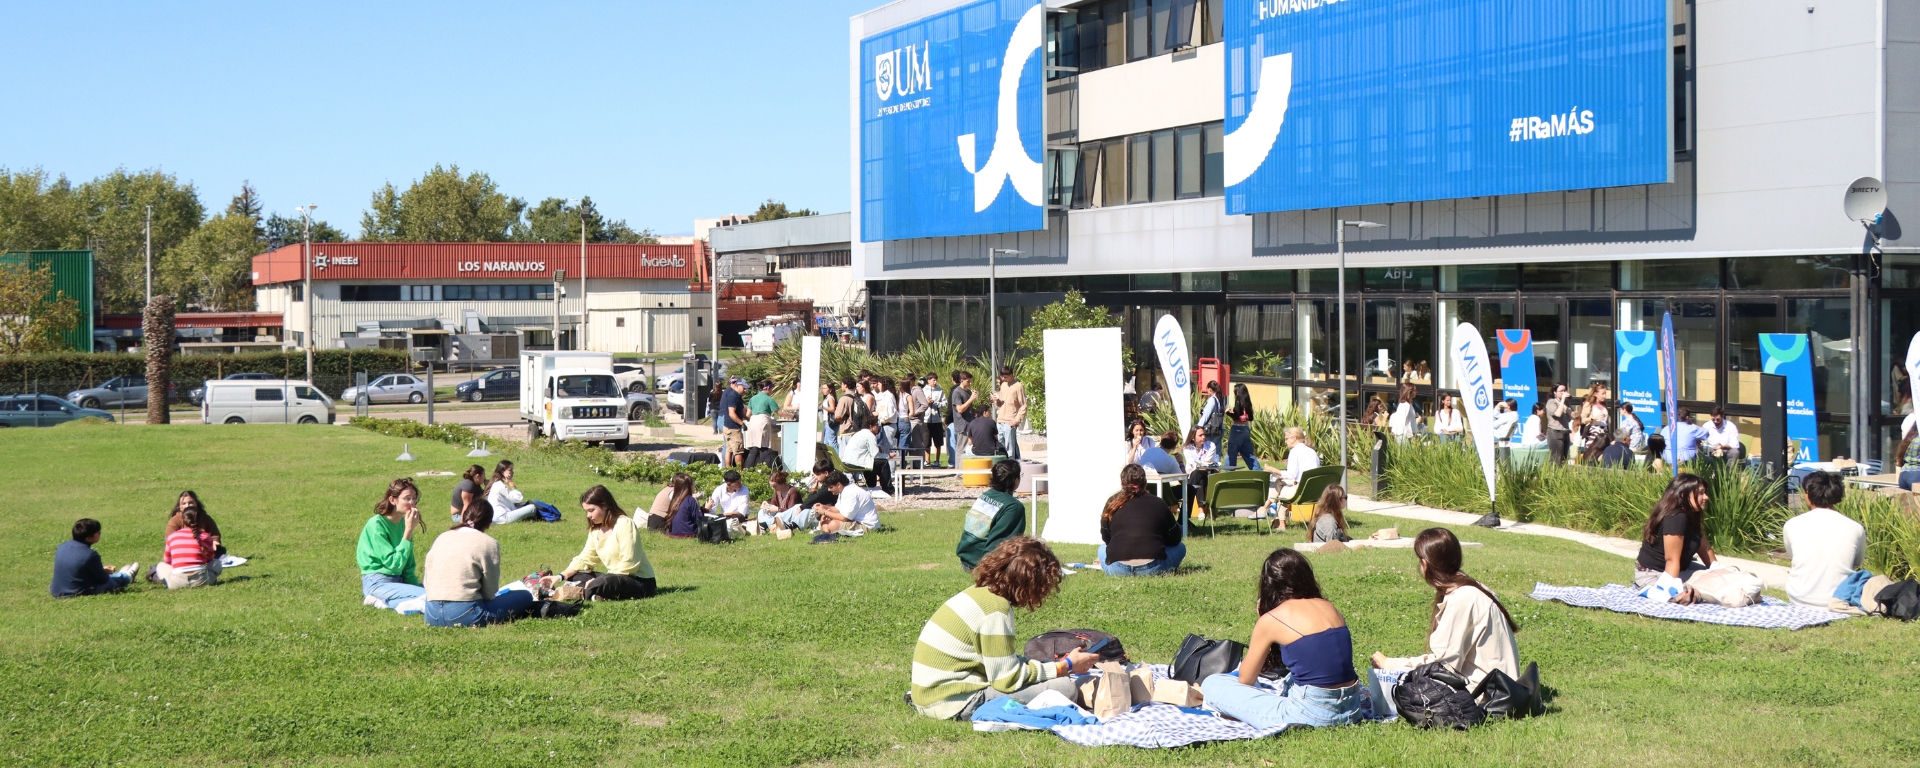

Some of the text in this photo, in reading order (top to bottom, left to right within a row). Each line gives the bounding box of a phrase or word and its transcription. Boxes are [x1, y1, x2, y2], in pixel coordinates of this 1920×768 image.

[1260, 0, 1346, 20] HUMANI
[894, 40, 932, 96] UM
[1509, 106, 1594, 141] #IRaMÁS
[458, 262, 545, 271] LOS NARANJOS
[1623, 390, 1644, 398] Facultad
[1787, 407, 1814, 416] nicación
[1797, 446, 1811, 461] M
